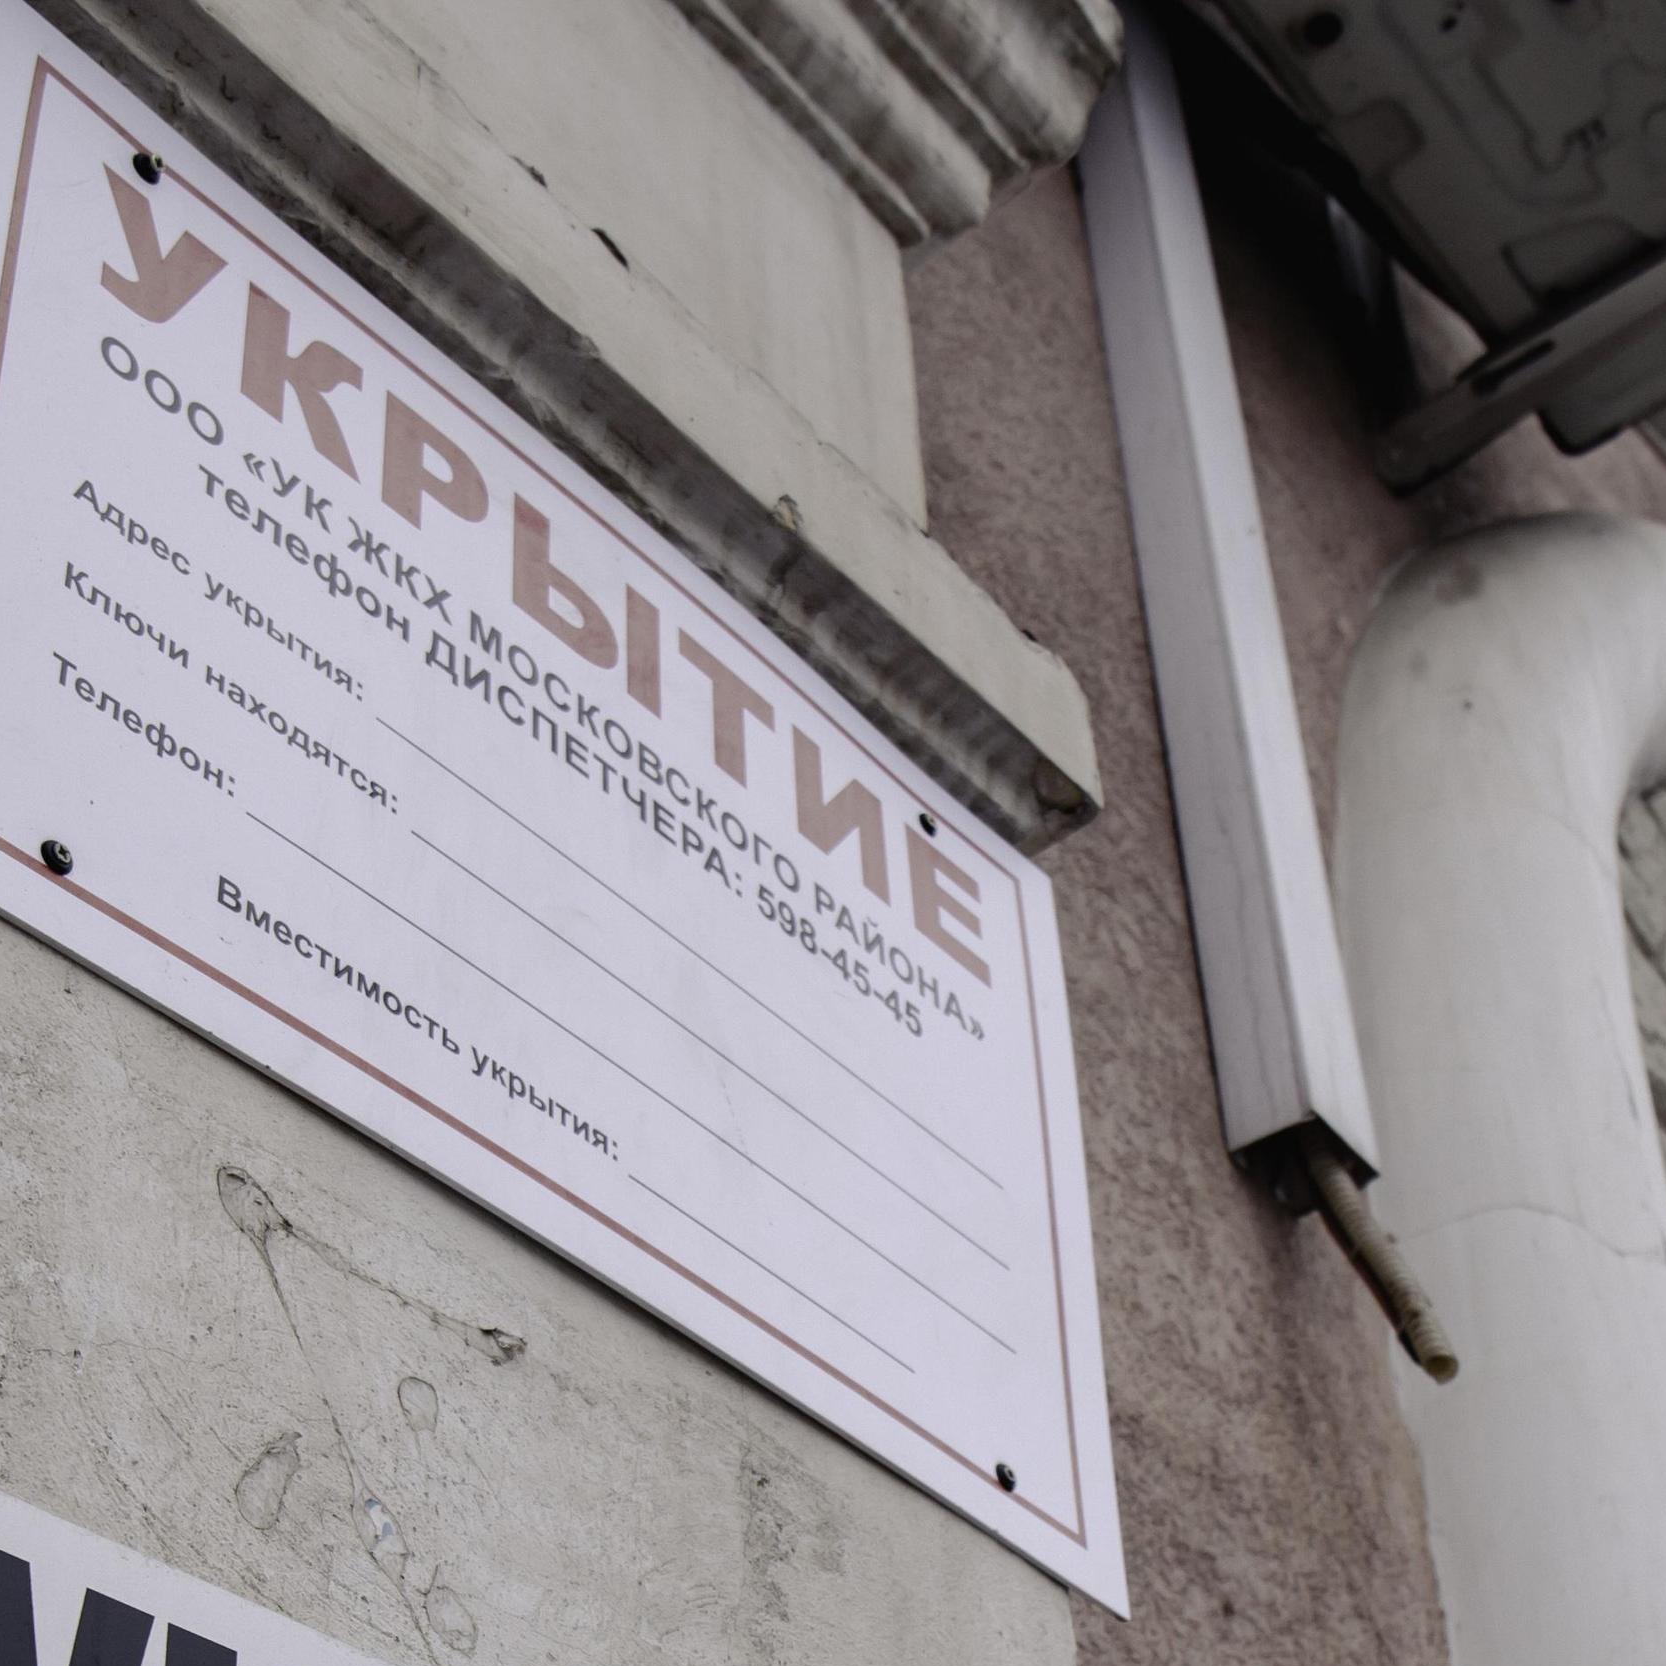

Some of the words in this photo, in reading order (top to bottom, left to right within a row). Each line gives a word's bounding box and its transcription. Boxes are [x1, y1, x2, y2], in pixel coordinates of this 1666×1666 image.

[64, 561, 189, 668] Ключи
[205, 665, 397, 814] находятся:
[72, 479, 190, 575] Адрес
[204, 572, 362, 701] укрытия:
[99, 161, 990, 987] УКРЫТИЕ
[100, 336, 223, 445] ООО
[242, 452, 332, 533] «УК
[347, 516, 451, 625] ЖКХ
[469, 610, 799, 892] МОСКОВСКОГО
[814, 882, 984, 1040] РАЙОНА»
[53, 651, 235, 797] Телефон:
[198, 463, 409, 642] телефон
[424, 630, 742, 897] ДИСПЕТЧЕРА:
[757, 883, 922, 1036] 598-45-45
[217, 874, 459, 1054] Вместимость
[471, 1045, 617, 1161] укрытия:
